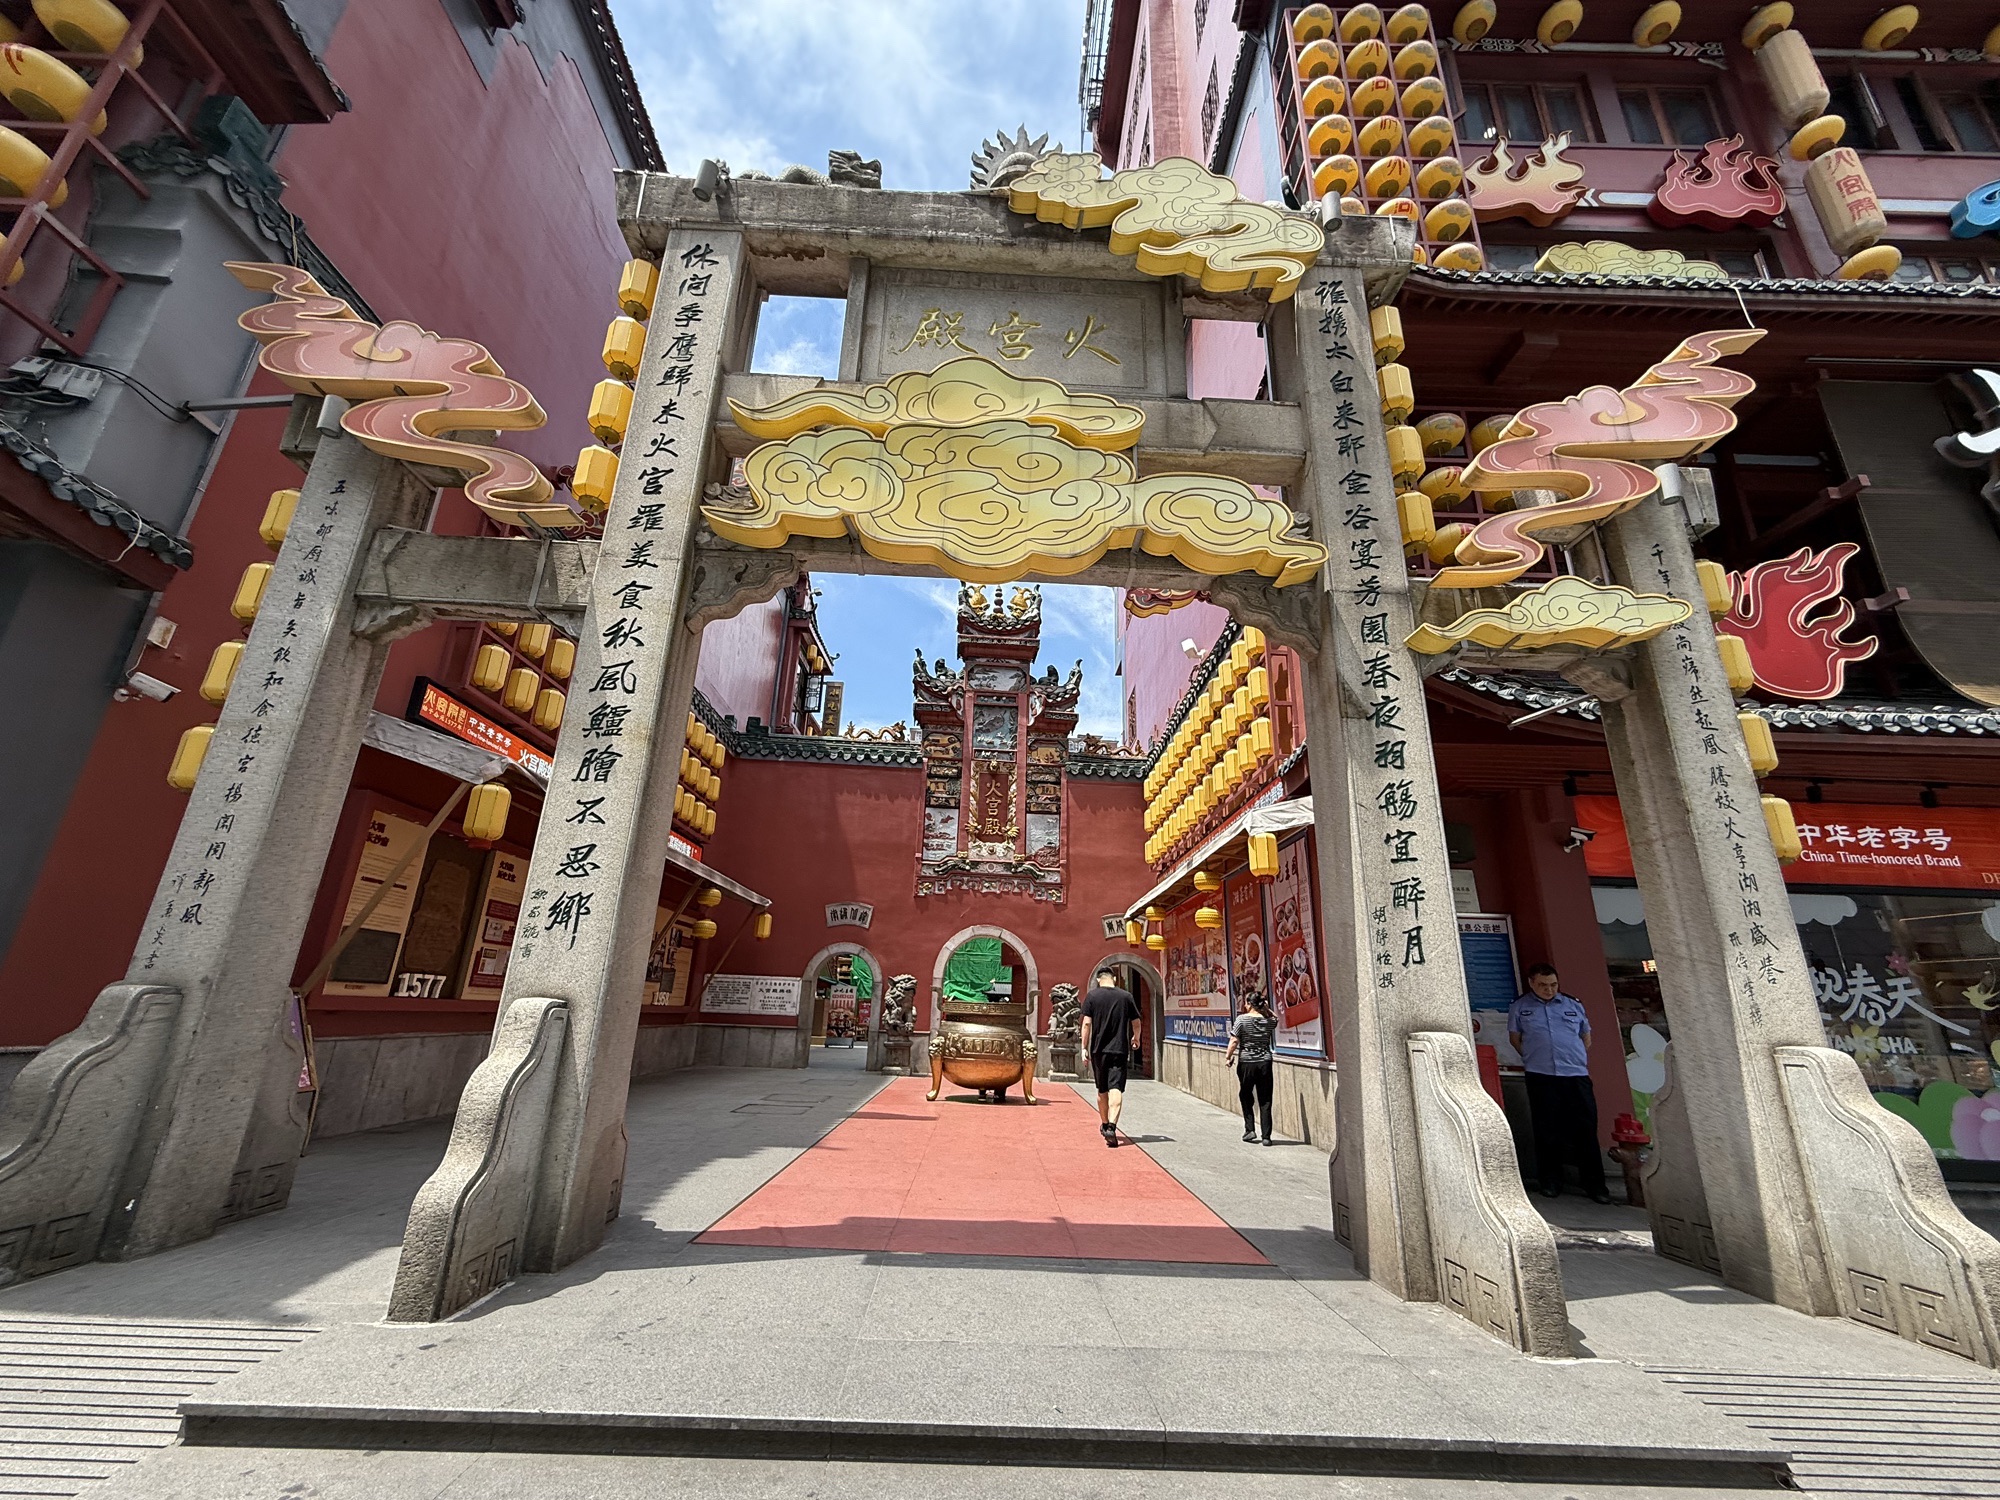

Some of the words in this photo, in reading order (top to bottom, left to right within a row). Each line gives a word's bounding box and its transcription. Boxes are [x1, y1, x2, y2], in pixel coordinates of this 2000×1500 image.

[1795, 823, 1952, 851] 中华老字号
[1800, 850, 1835, 863] China
[1837, 851, 1922, 866] Time-honored
[1925, 853, 1962, 867] Brand
[394, 973, 447, 999] 1577
